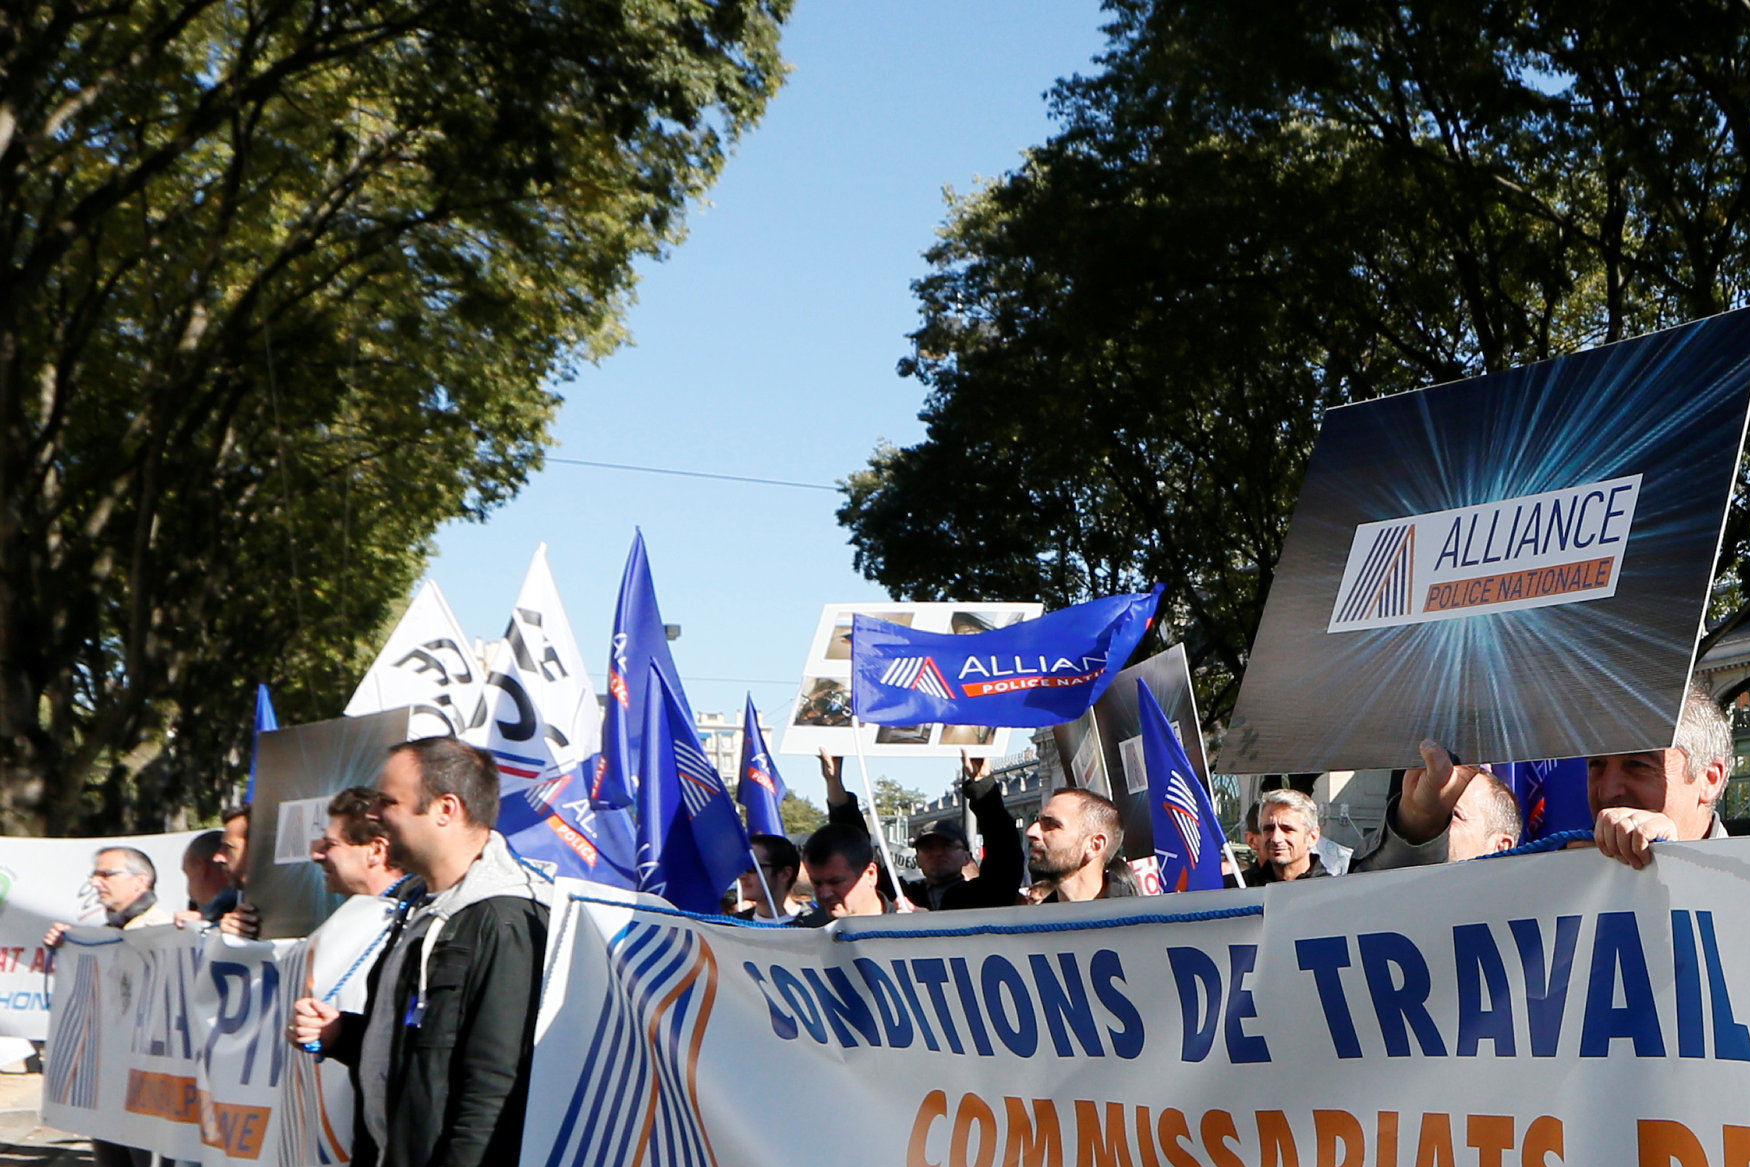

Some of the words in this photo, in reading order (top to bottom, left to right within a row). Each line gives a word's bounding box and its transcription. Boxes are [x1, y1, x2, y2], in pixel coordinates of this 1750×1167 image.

[1434, 485, 1632, 570] ALLIANCE
[1426, 578, 1494, 609] POLICE
[1497, 560, 1610, 601] NATIONALE
[982, 678, 1049, 694] POLICE
[557, 825, 597, 862] POLICE
[743, 949, 1145, 1060] CONDITIONS
[1167, 944, 1270, 1063] DE
